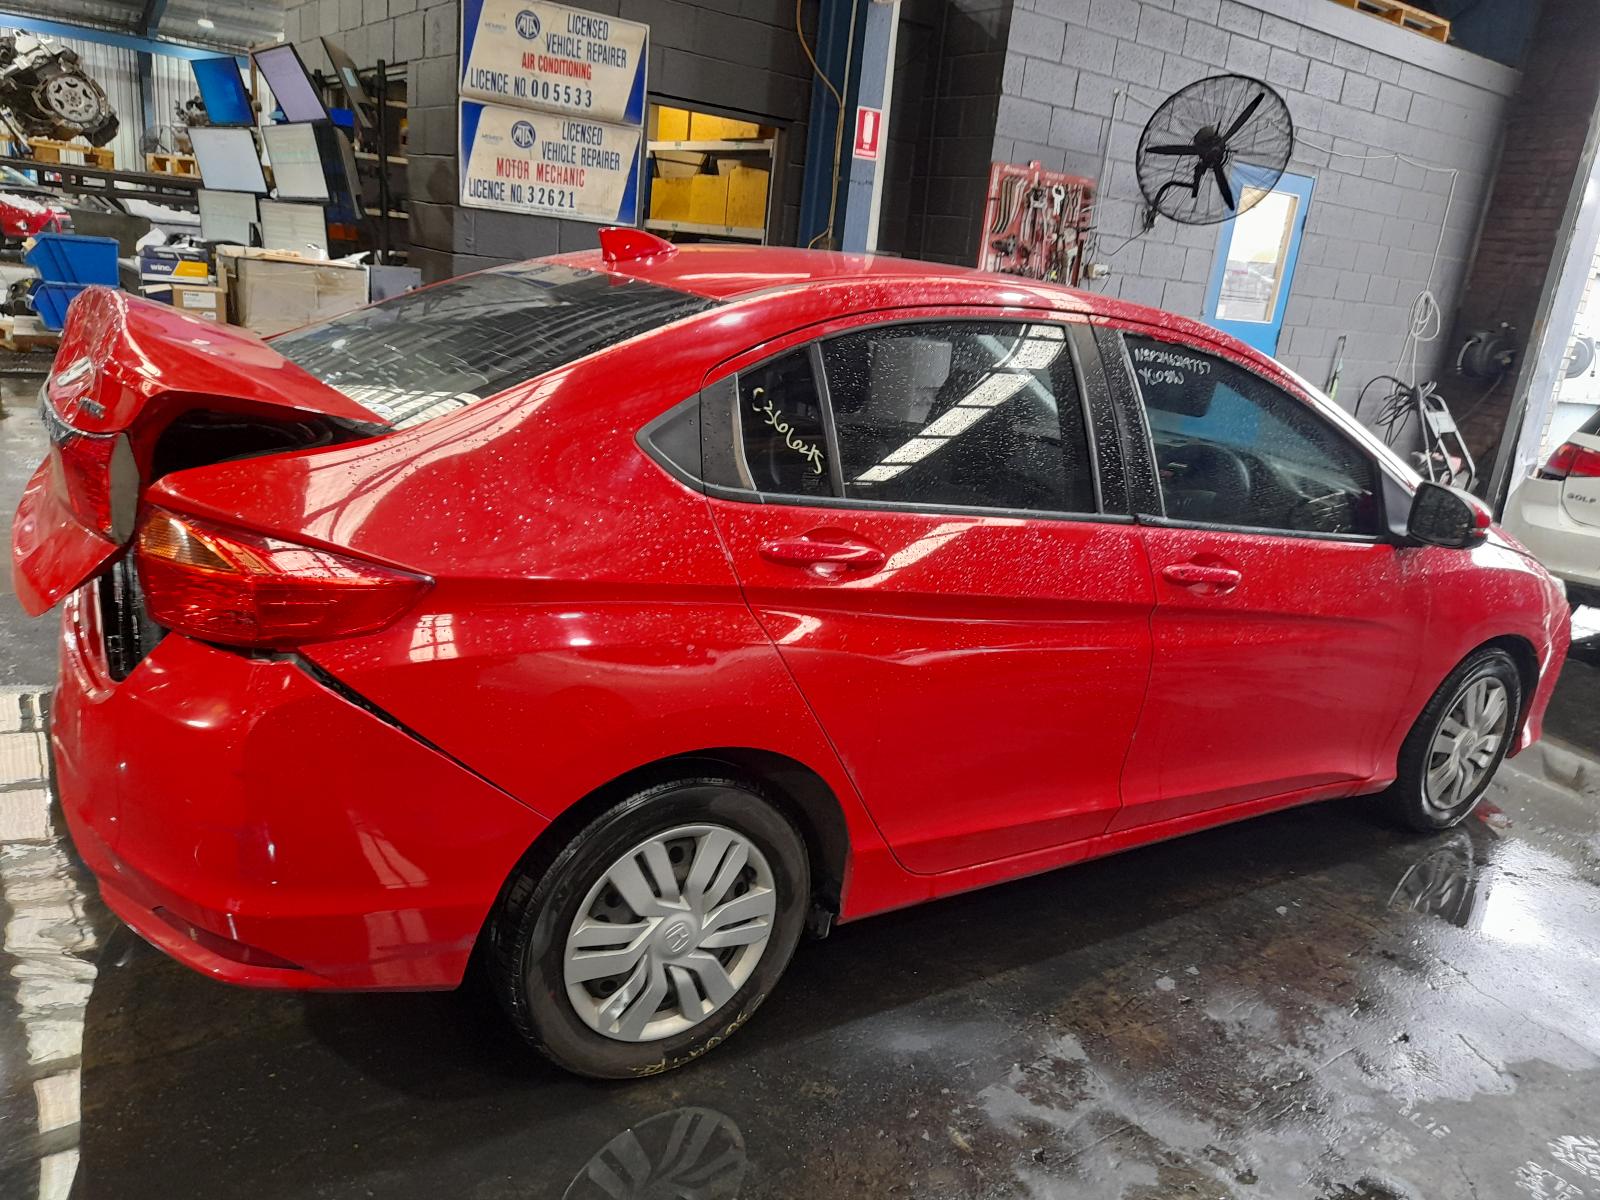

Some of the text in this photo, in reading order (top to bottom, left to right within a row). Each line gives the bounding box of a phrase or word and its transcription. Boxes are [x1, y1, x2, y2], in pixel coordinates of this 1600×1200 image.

[567, 13, 609, 41] LICENSED
[546, 32, 627, 69] VEHICLE REPAIRER
[522, 52, 592, 81] AIR CONDITIONING
[470, 68, 509, 95] LICENCE
[531, 79, 592, 108] 005533
[561, 121, 603, 146] LICENSED
[541, 141, 620, 172] VEHICLE REPAIRER
[496, 157, 586, 188] MOTOR MECHANIC
[468, 177, 505, 202] LICENCE
[527, 186, 576, 209] 32621
[1566, 492, 1597, 503] GOLF
